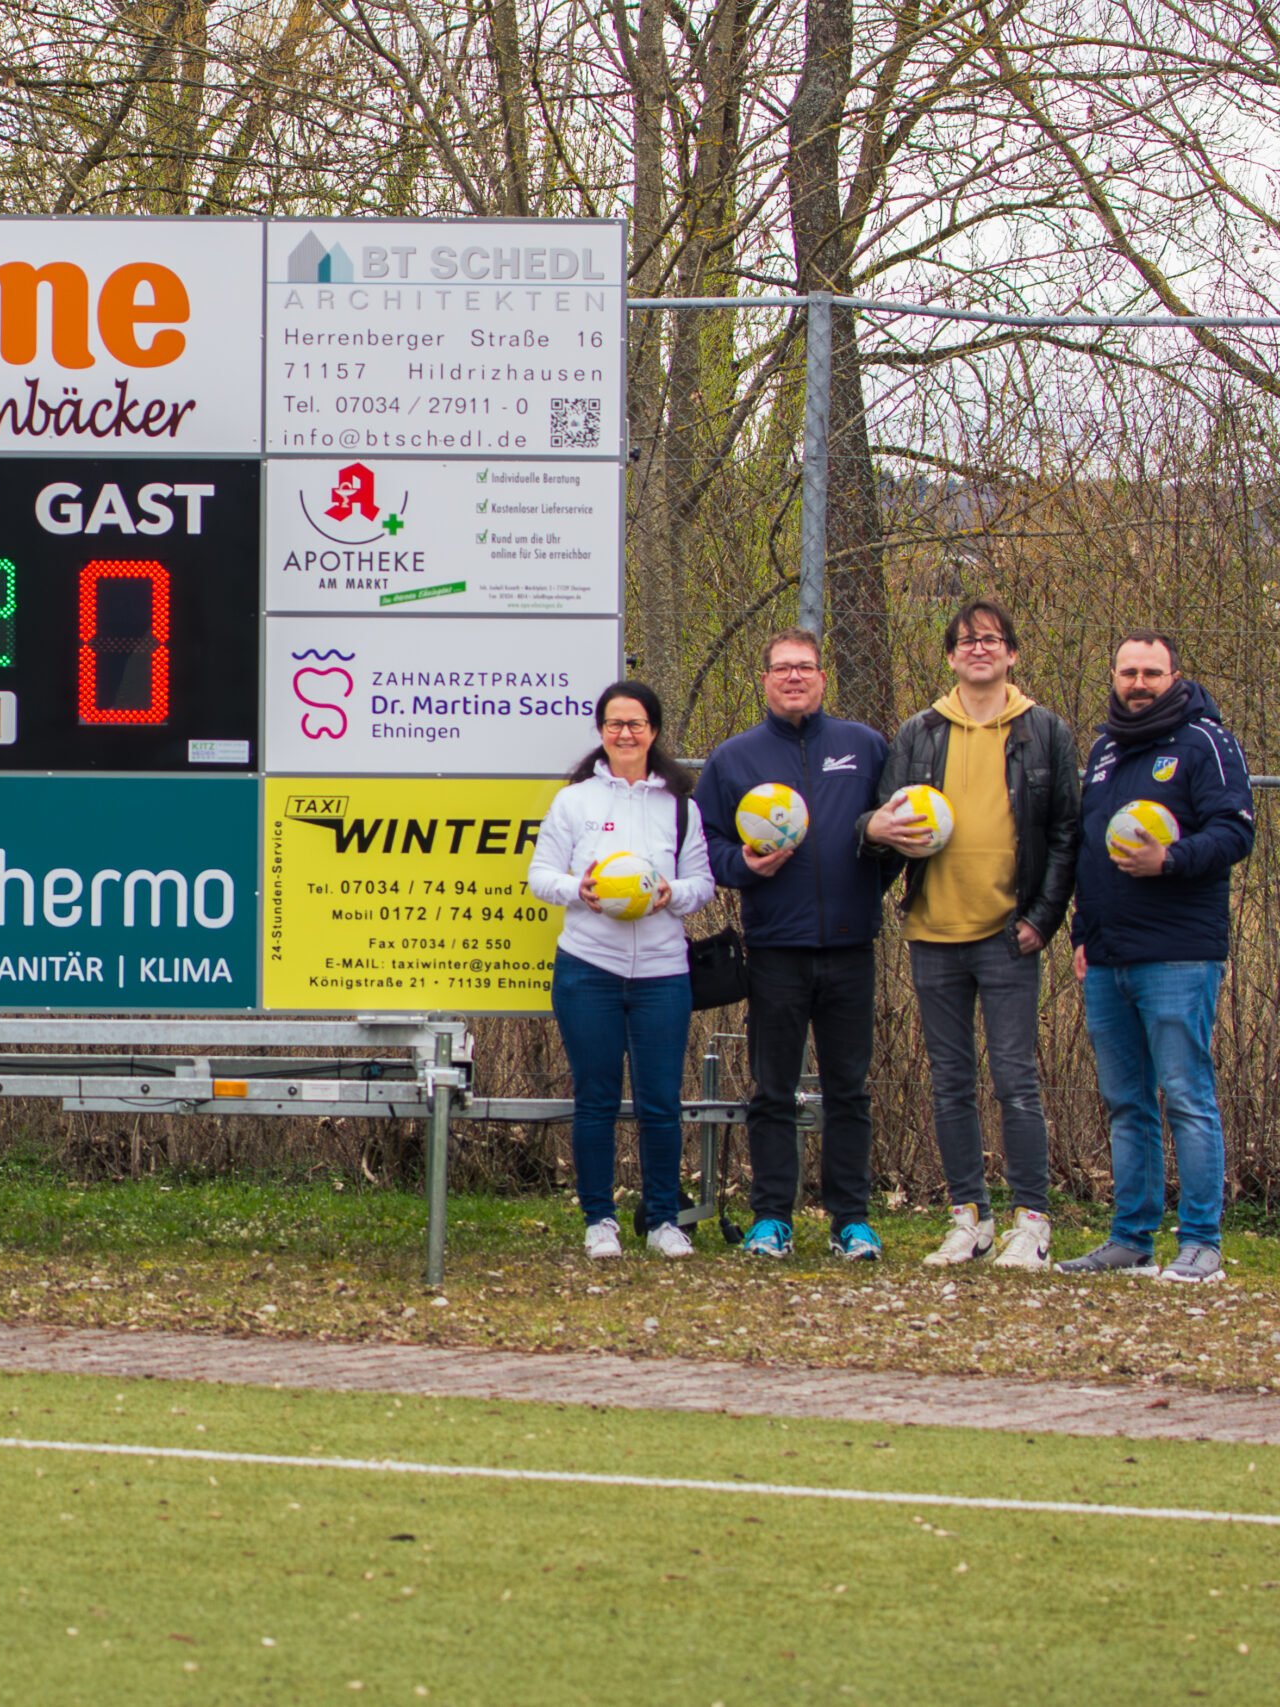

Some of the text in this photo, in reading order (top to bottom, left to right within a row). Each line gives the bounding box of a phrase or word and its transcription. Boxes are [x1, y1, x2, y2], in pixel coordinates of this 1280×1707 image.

[362, 246, 605, 280] BT SCHEDL
[284, 289, 605, 312] ARCHITEKTEN
[284, 328, 603, 350] Herrenberger Straße 16
[284, 362, 603, 382] 71157 Hildrizhausen
[284, 395, 320, 413] Tel.
[336, 396, 400, 414] 07034
[429, 397, 491, 414] 27911
[516, 398, 528, 414] 0
[283, 429, 527, 449] info@btschedl.de
[491, 472, 580, 486] Individuelle Beratung
[35, 482, 215, 535] GAST
[491, 502, 593, 514] Kostenloser Lieferservice
[491, 532, 560, 544] Rund um die Uhr
[283, 551, 425, 572] APOTHEKE
[491, 548, 591, 559] online für Sie erreichbar
[319, 578, 389, 590] AM MARKT
[78, 560, 170, 724] 0
[372, 672, 569, 687] ZAHNARZTPRAXIS
[372, 695, 594, 716] Dr. Martina Sachs
[372, 723, 460, 742] Ehningen
[294, 800, 342, 813] TAXI
[335, 818, 545, 855] WINTER
[271, 820, 283, 961] 24-Stunden-Service
[308, 883, 333, 894] Tel.
[341, 881, 400, 894] 07034
[423, 881, 445, 894] 74
[455, 881, 477, 894] 94
[484, 883, 512, 895] und
[520, 882, 528, 895] 7
[332, 909, 372, 921] Mobil
[380, 907, 427, 921] 0172
[451, 907, 472, 921] 74
[482, 907, 504, 921] 94
[513, 907, 548, 922] 400
[369, 938, 395, 949] Fax
[402, 938, 445, 949] 07034
[462, 938, 478, 949] 62
[486, 939, 511, 950] 550
[140, 958, 233, 984] KLIMA
[326, 958, 553, 972] E-MAIL: taxiwinter@yahoo.de
[309, 976, 402, 989] Königstraße
[410, 977, 426, 988] 21
[448, 978, 491, 988] 71139
